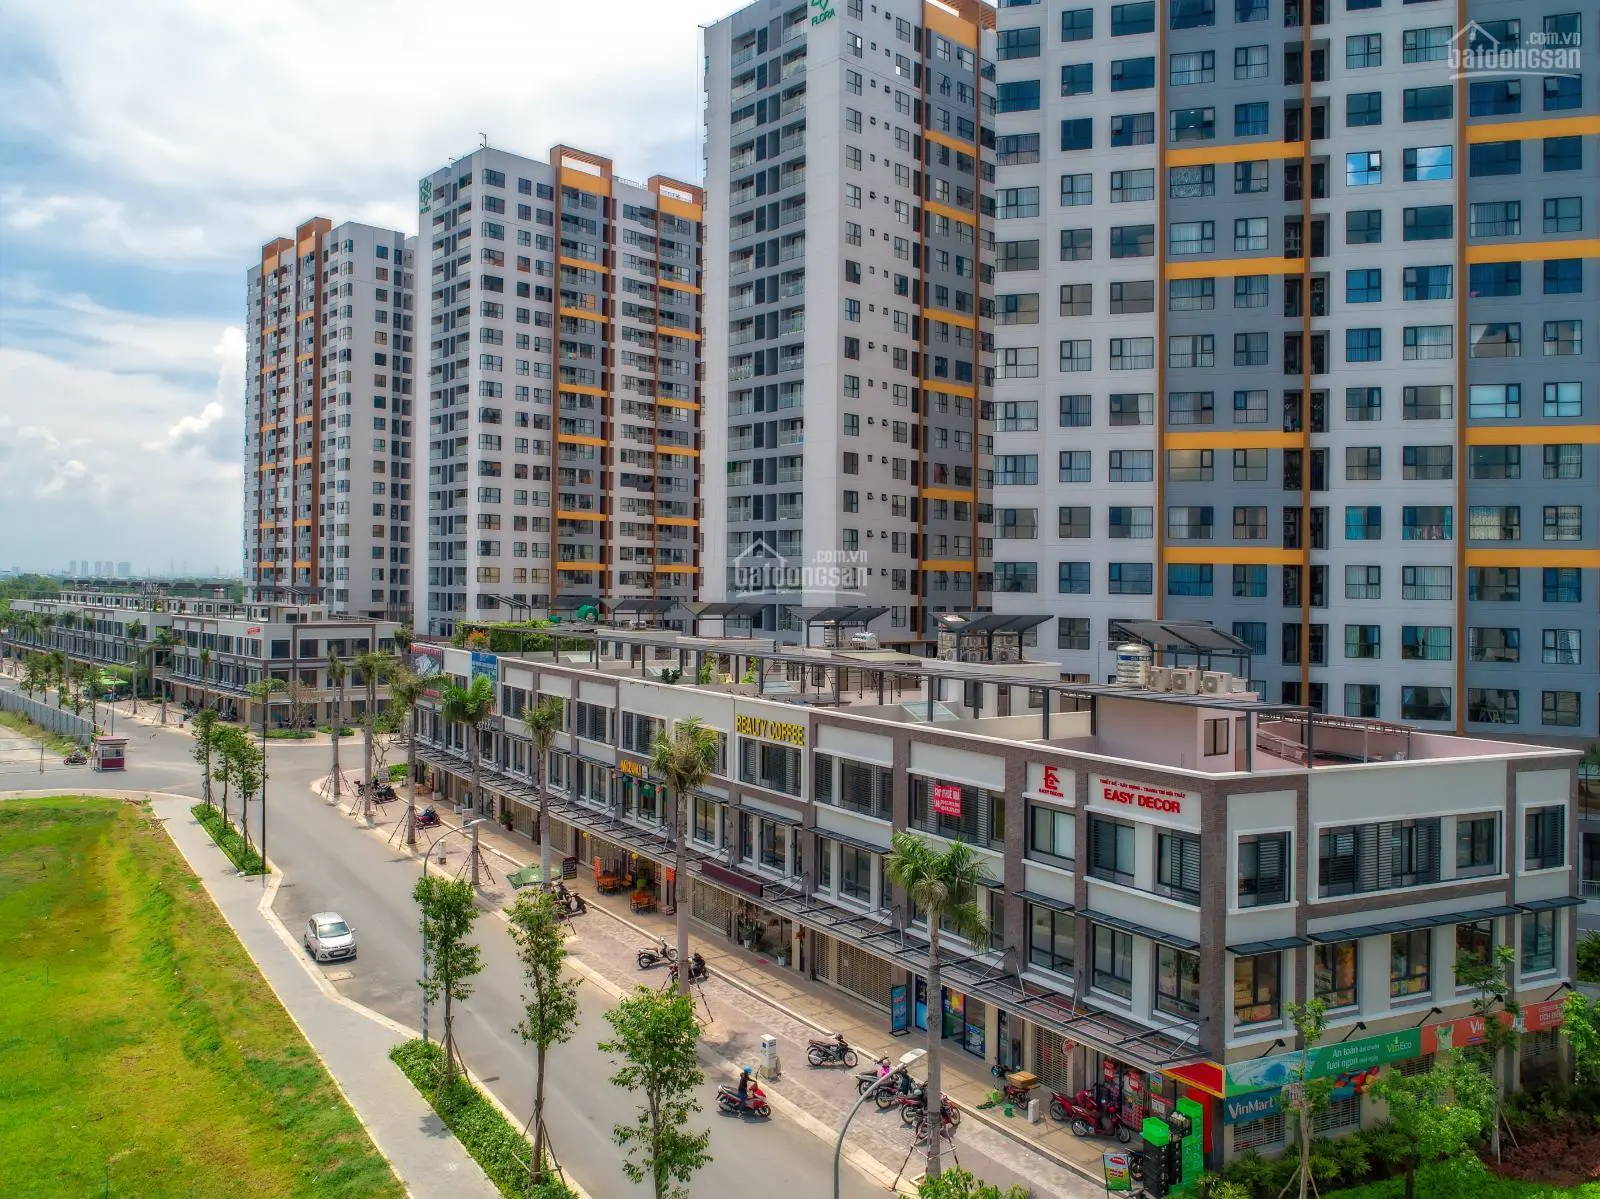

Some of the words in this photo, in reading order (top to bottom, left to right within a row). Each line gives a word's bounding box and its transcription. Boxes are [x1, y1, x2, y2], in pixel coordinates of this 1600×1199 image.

[811, 8, 835, 27] FLORA
[736, 715, 768, 737] REALTY
[769, 721, 805, 745] COFFEE
[1104, 788, 1134, 804] EASY
[1137, 794, 1181, 814] DECOR
[1332, 1048, 1342, 1058] An
[1228, 1096, 1274, 1119] VinMart
